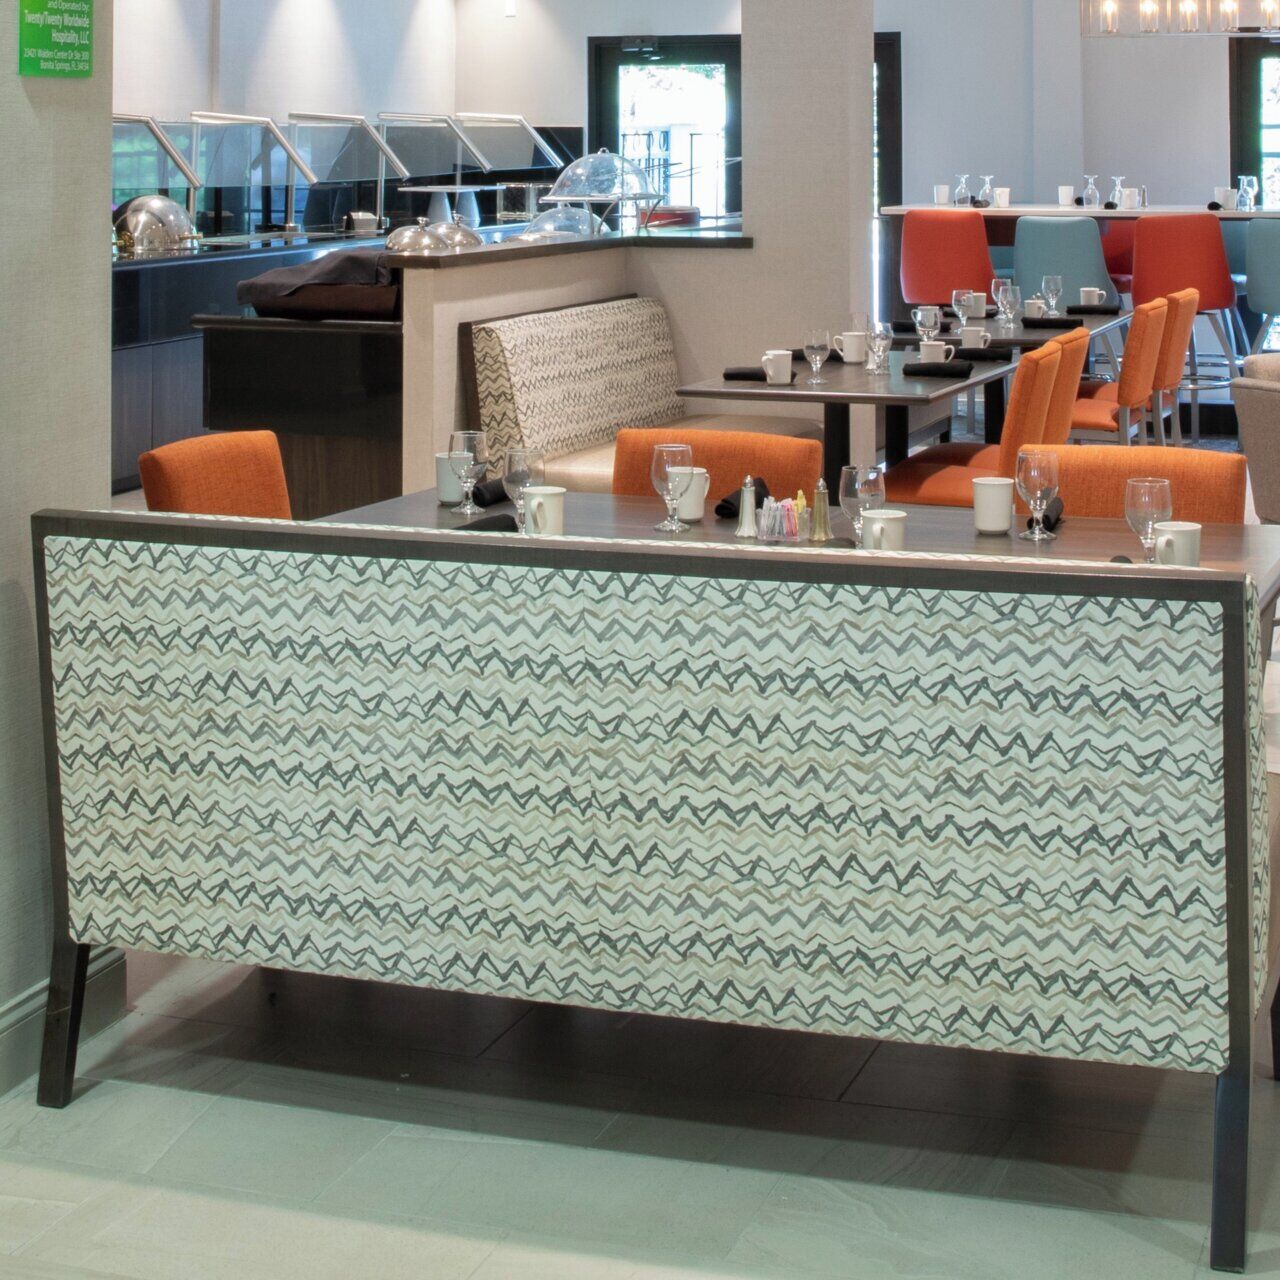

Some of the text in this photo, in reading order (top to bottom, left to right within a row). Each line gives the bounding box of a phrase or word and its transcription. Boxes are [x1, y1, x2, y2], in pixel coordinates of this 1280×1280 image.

[48, 0, 58, 9] and
[59, 0, 81, 11] Operated
[63, 13, 90, 28] Worldwide
[80, 30, 90, 44] LLC
